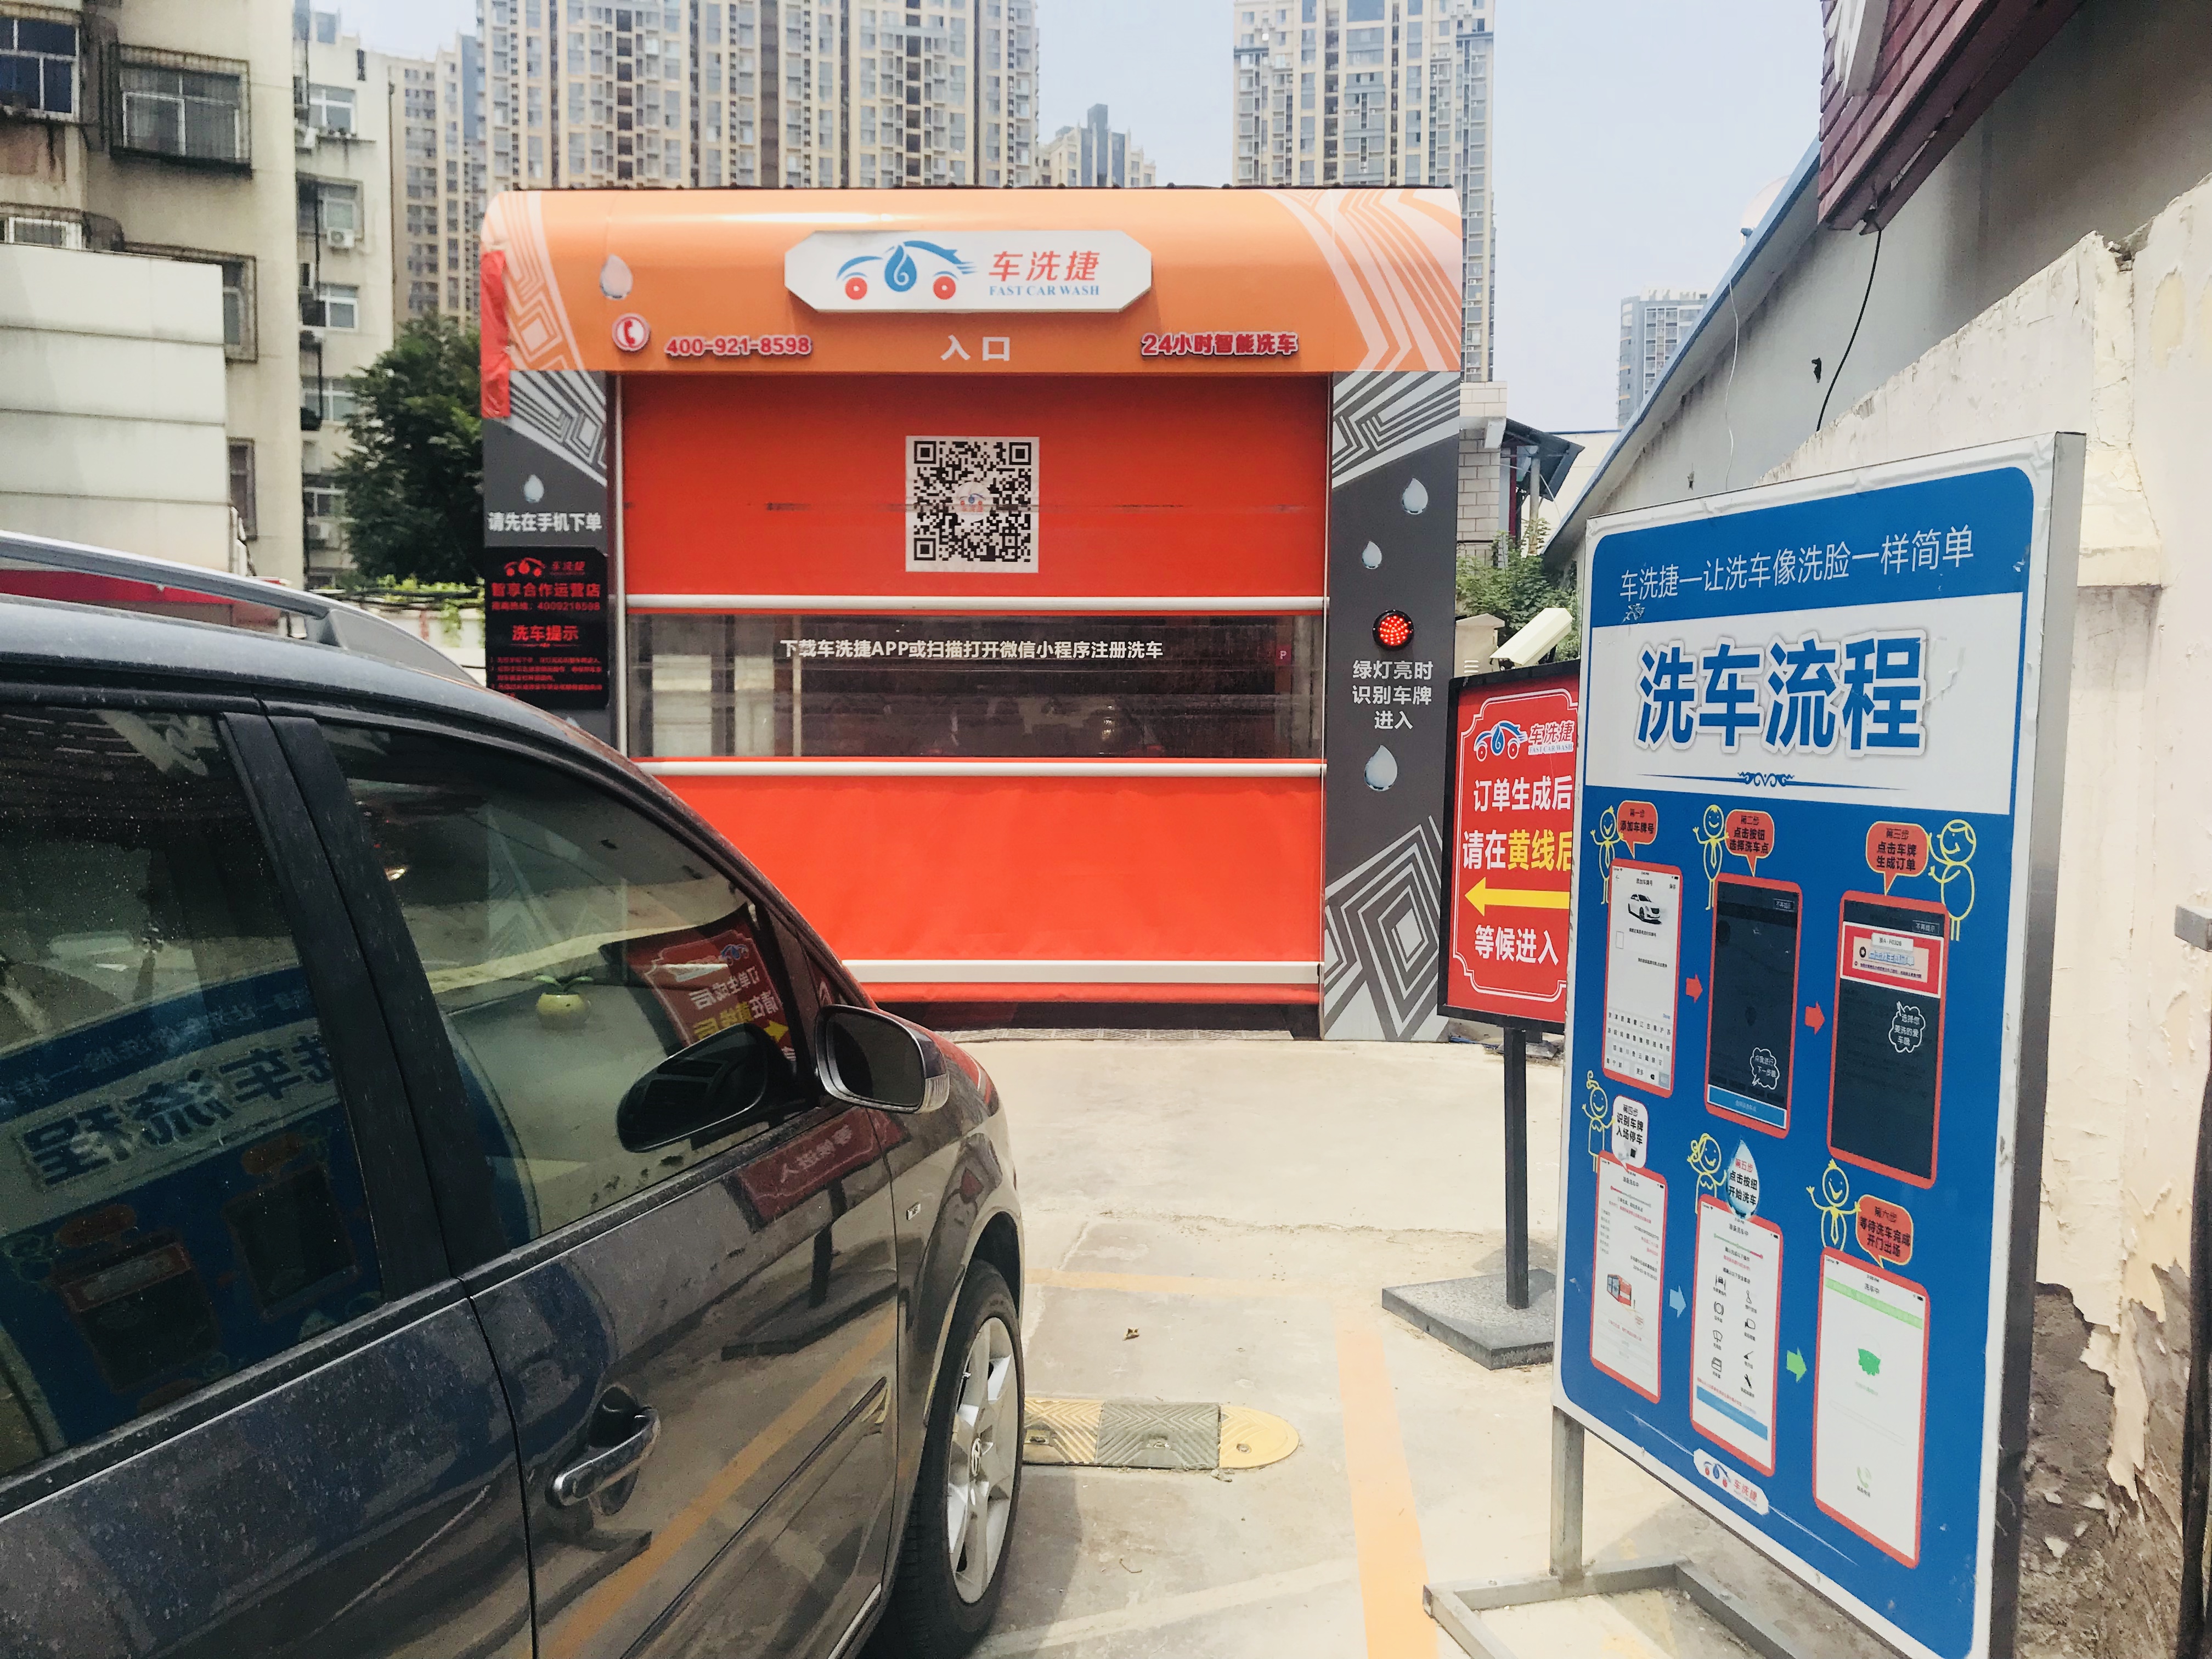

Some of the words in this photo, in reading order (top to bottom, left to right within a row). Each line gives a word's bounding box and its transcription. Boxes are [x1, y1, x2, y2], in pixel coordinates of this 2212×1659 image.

[989, 250, 1100, 282] 车洗捷
[989, 285, 1023, 296] FAST
[1026, 285, 1056, 296] CAR
[1059, 285, 1099, 296] WASH
[665, 335, 812, 356] 400-921-8598
[940, 334, 1011, 362] 入口
[1141, 331, 1299, 357] 24小时智能洗车
[488, 511, 602, 533] 请先在手机下单
[511, 624, 579, 641] 洗车提示
[780, 638, 1164, 660] 下载车洗捷APP或扫描打开微信小程序注册洗车
[1352, 659, 1434, 681] 绿灯亮时
[1351, 685, 1433, 706] 识别车牌
[1637, 634, 1923, 753] 洗车流程
[1374, 710, 1414, 730] 进入
[1529, 721, 1575, 744] 车洗捷
[1557, 743, 1572, 752] WASH
[1474, 774, 1573, 812] 订单生成后
[1620, 820, 1655, 834] 添加车牌号
[1462, 828, 1573, 872] 请在黄线后
[1729, 839, 1769, 854] 选择洗车点
[1876, 841, 1917, 857] 点击车牌
[1876, 856, 1916, 871] 生成订单
[1474, 924, 1560, 966] 等候进入
[1623, 1104, 1639, 1117] 第四步
[1616, 1112, 1644, 1133] 识别车牌
[1616, 1126, 1643, 1145] 入场停车
[1734, 1158, 1754, 1173] 第五步
[1728, 1185, 1757, 1206] 开始洗车
[1866, 1234, 1901, 1257] 开门出场
[1733, 1479, 1757, 1502] 车洗捷
